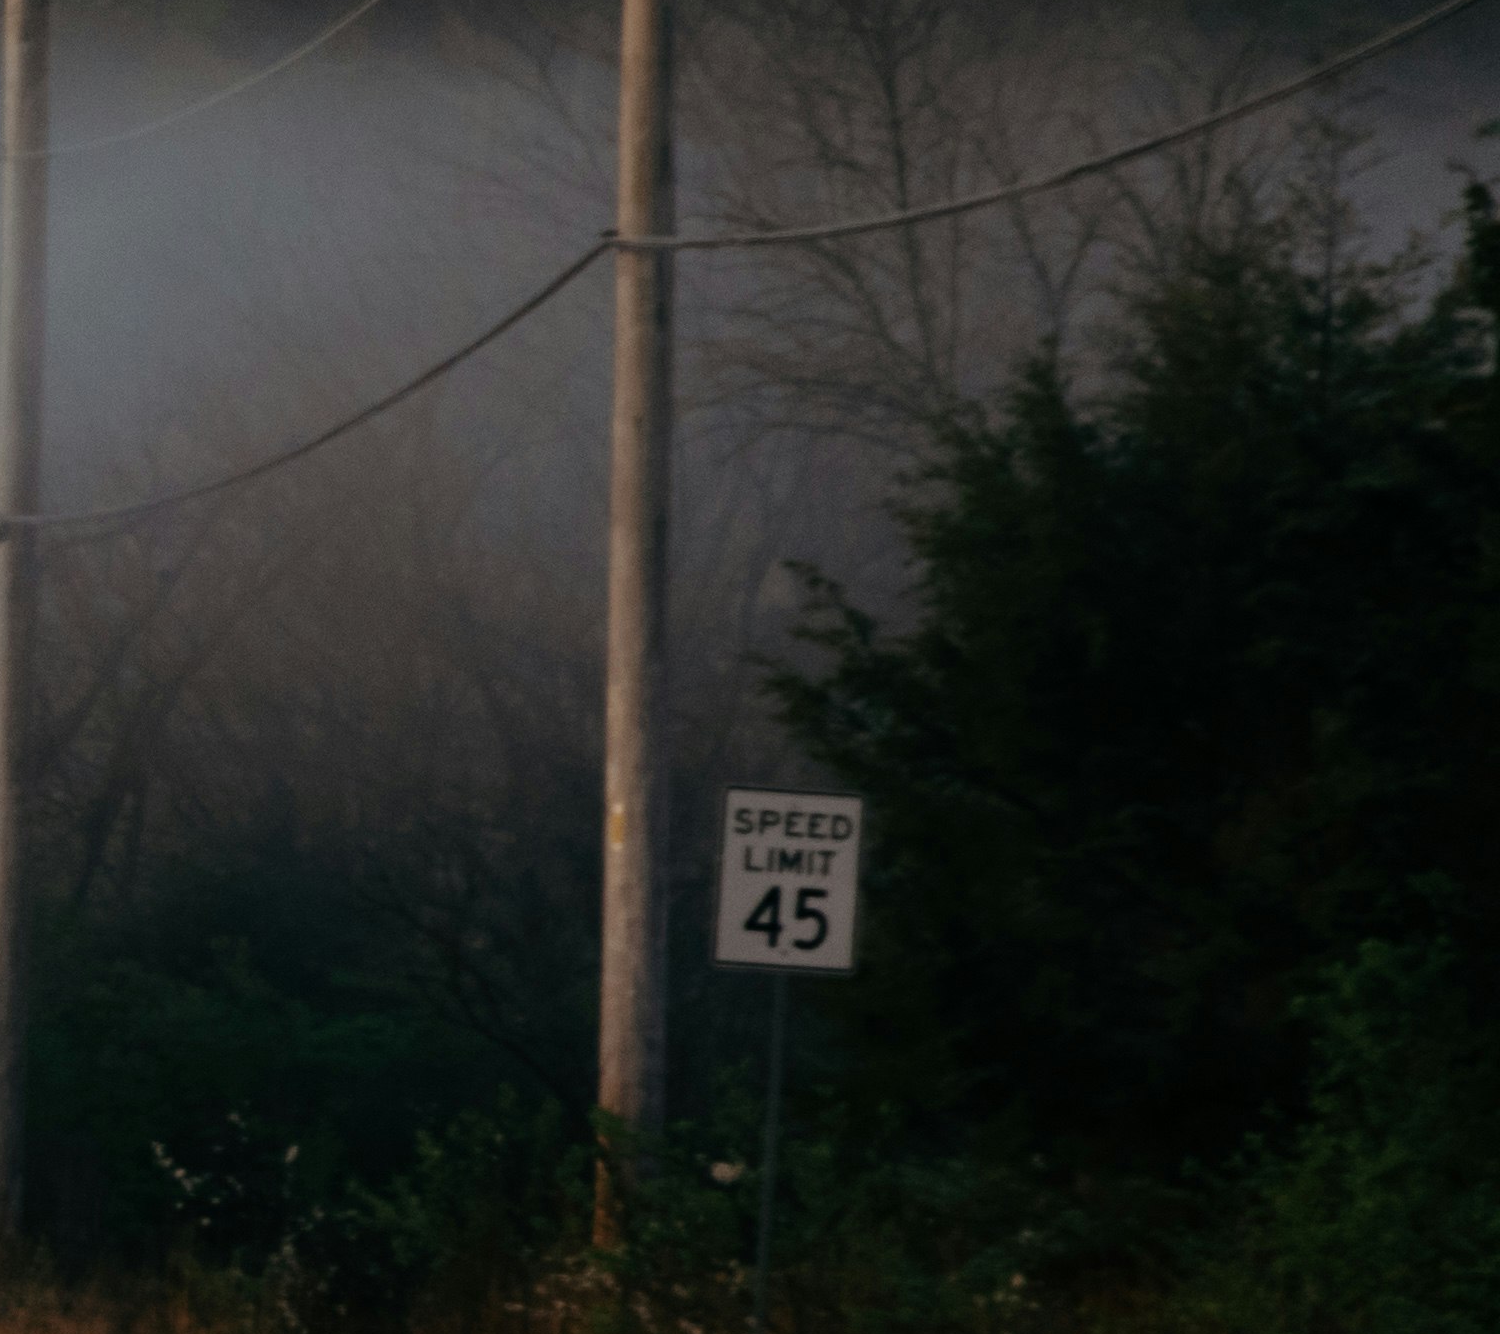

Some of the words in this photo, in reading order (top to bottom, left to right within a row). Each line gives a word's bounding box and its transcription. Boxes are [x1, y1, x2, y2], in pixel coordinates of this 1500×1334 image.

[734, 808, 853, 841] SPEED
[744, 845, 835, 875] LIMIT
[744, 885, 828, 950] 45
